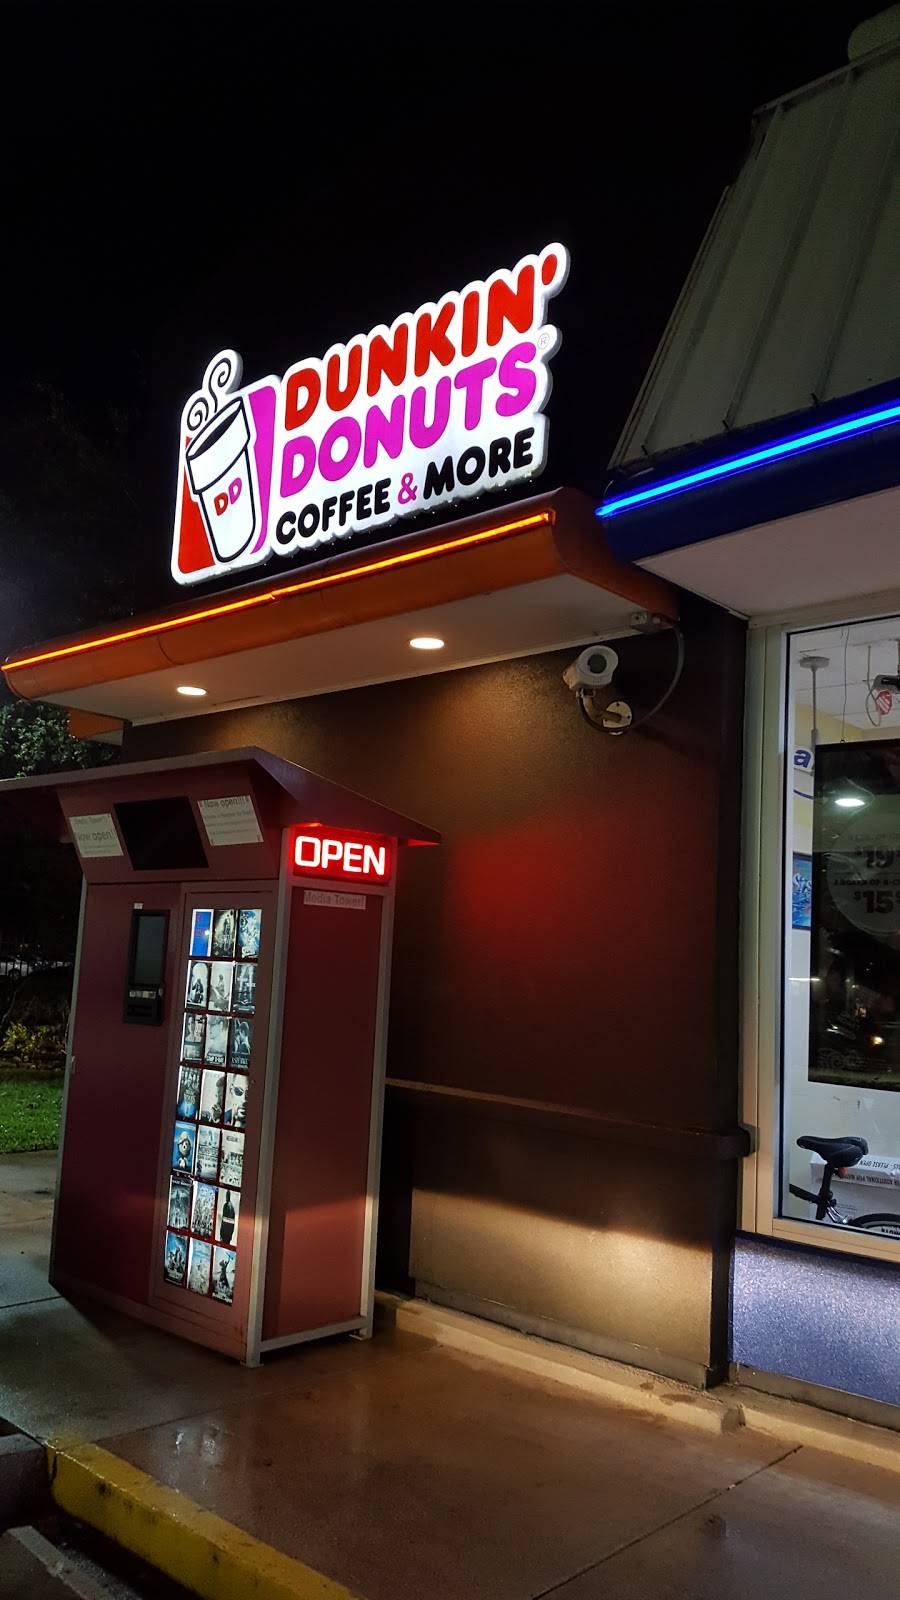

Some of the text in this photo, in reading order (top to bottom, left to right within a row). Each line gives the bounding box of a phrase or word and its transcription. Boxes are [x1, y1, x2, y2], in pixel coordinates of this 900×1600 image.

[285, 254, 558, 431] DUNKIN'
[279, 342, 537, 498] DONUTS
[275, 427, 535, 545] COFFEE & MORE
[294, 835, 386, 875] OPEN
[304, 891, 332, 905] Media
